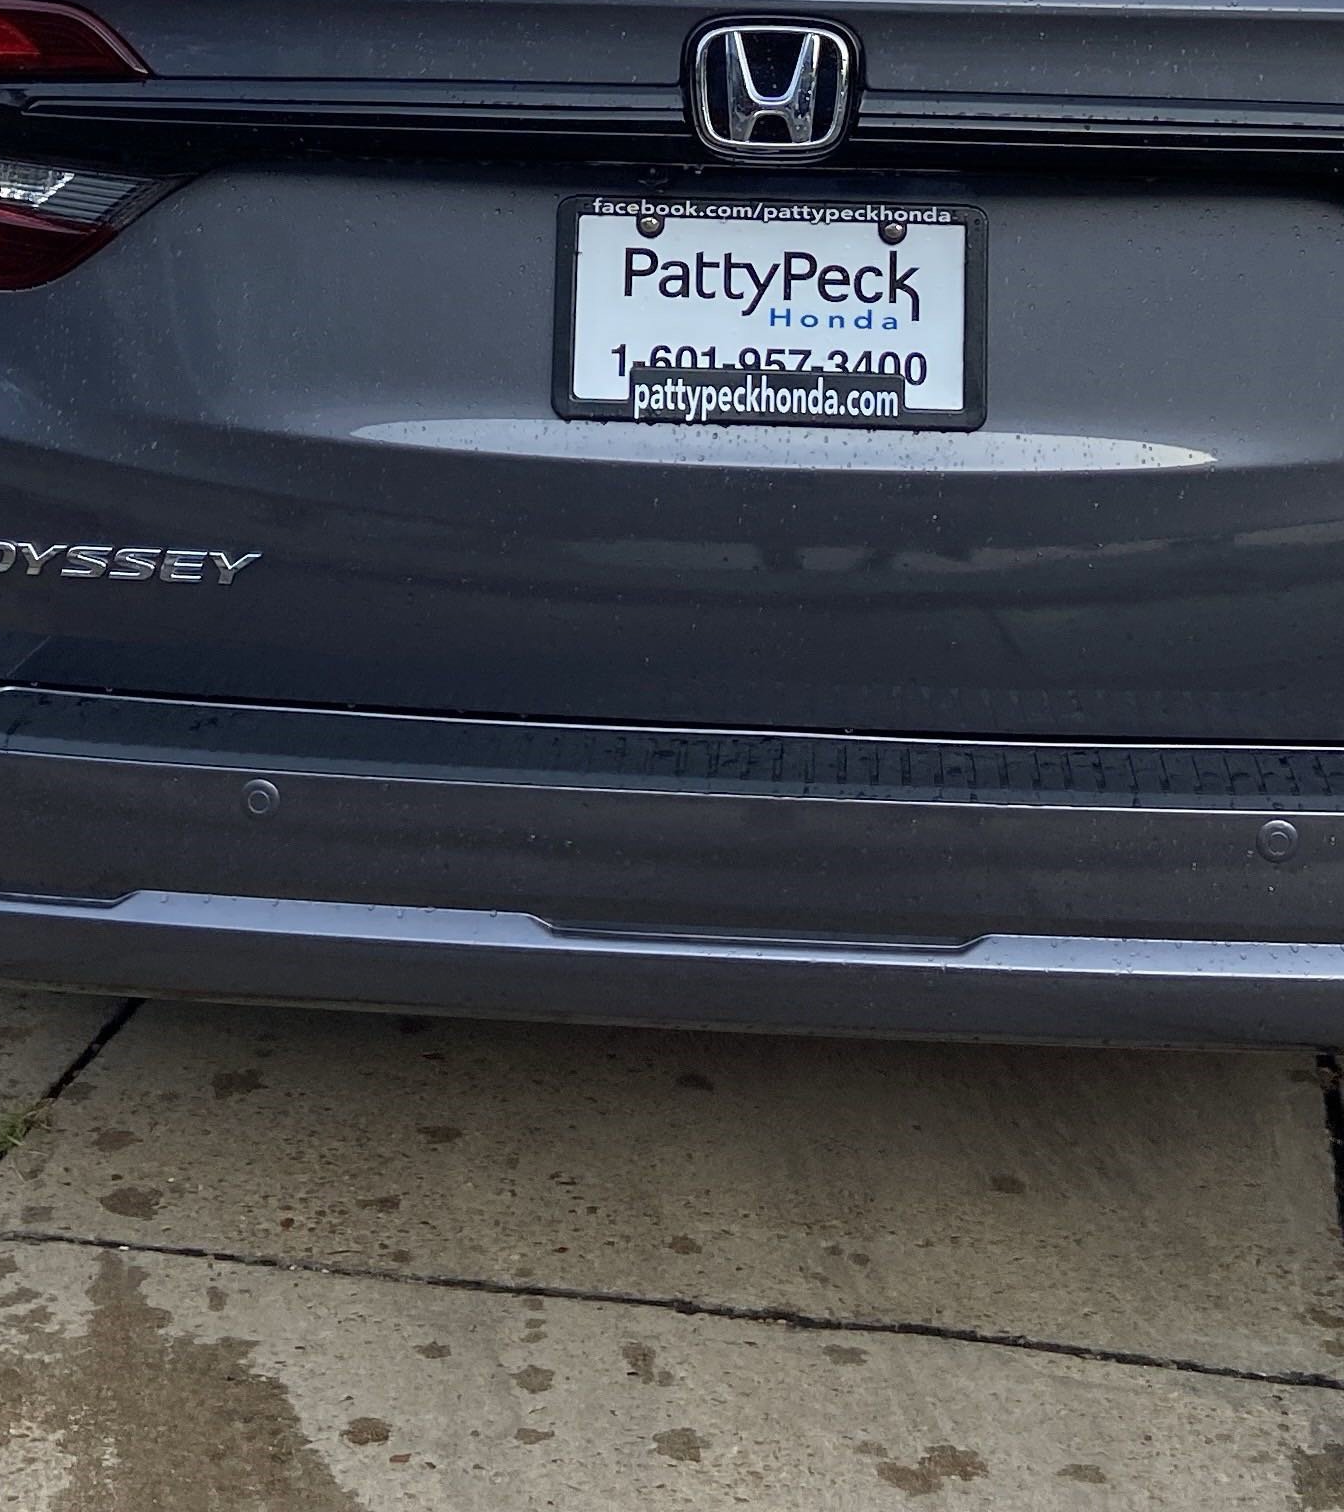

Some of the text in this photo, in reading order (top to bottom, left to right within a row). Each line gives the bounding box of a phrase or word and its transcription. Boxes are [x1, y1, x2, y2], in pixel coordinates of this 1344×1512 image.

[592, 197, 952, 225] facebook.com/pattypeckhonda
[623, 246, 921, 322] PattyPeck
[769, 308, 899, 330] Honda
[611, 343, 928, 386] 1-601-957-3400
[633, 374, 900, 421] pattypeckhonda.com
